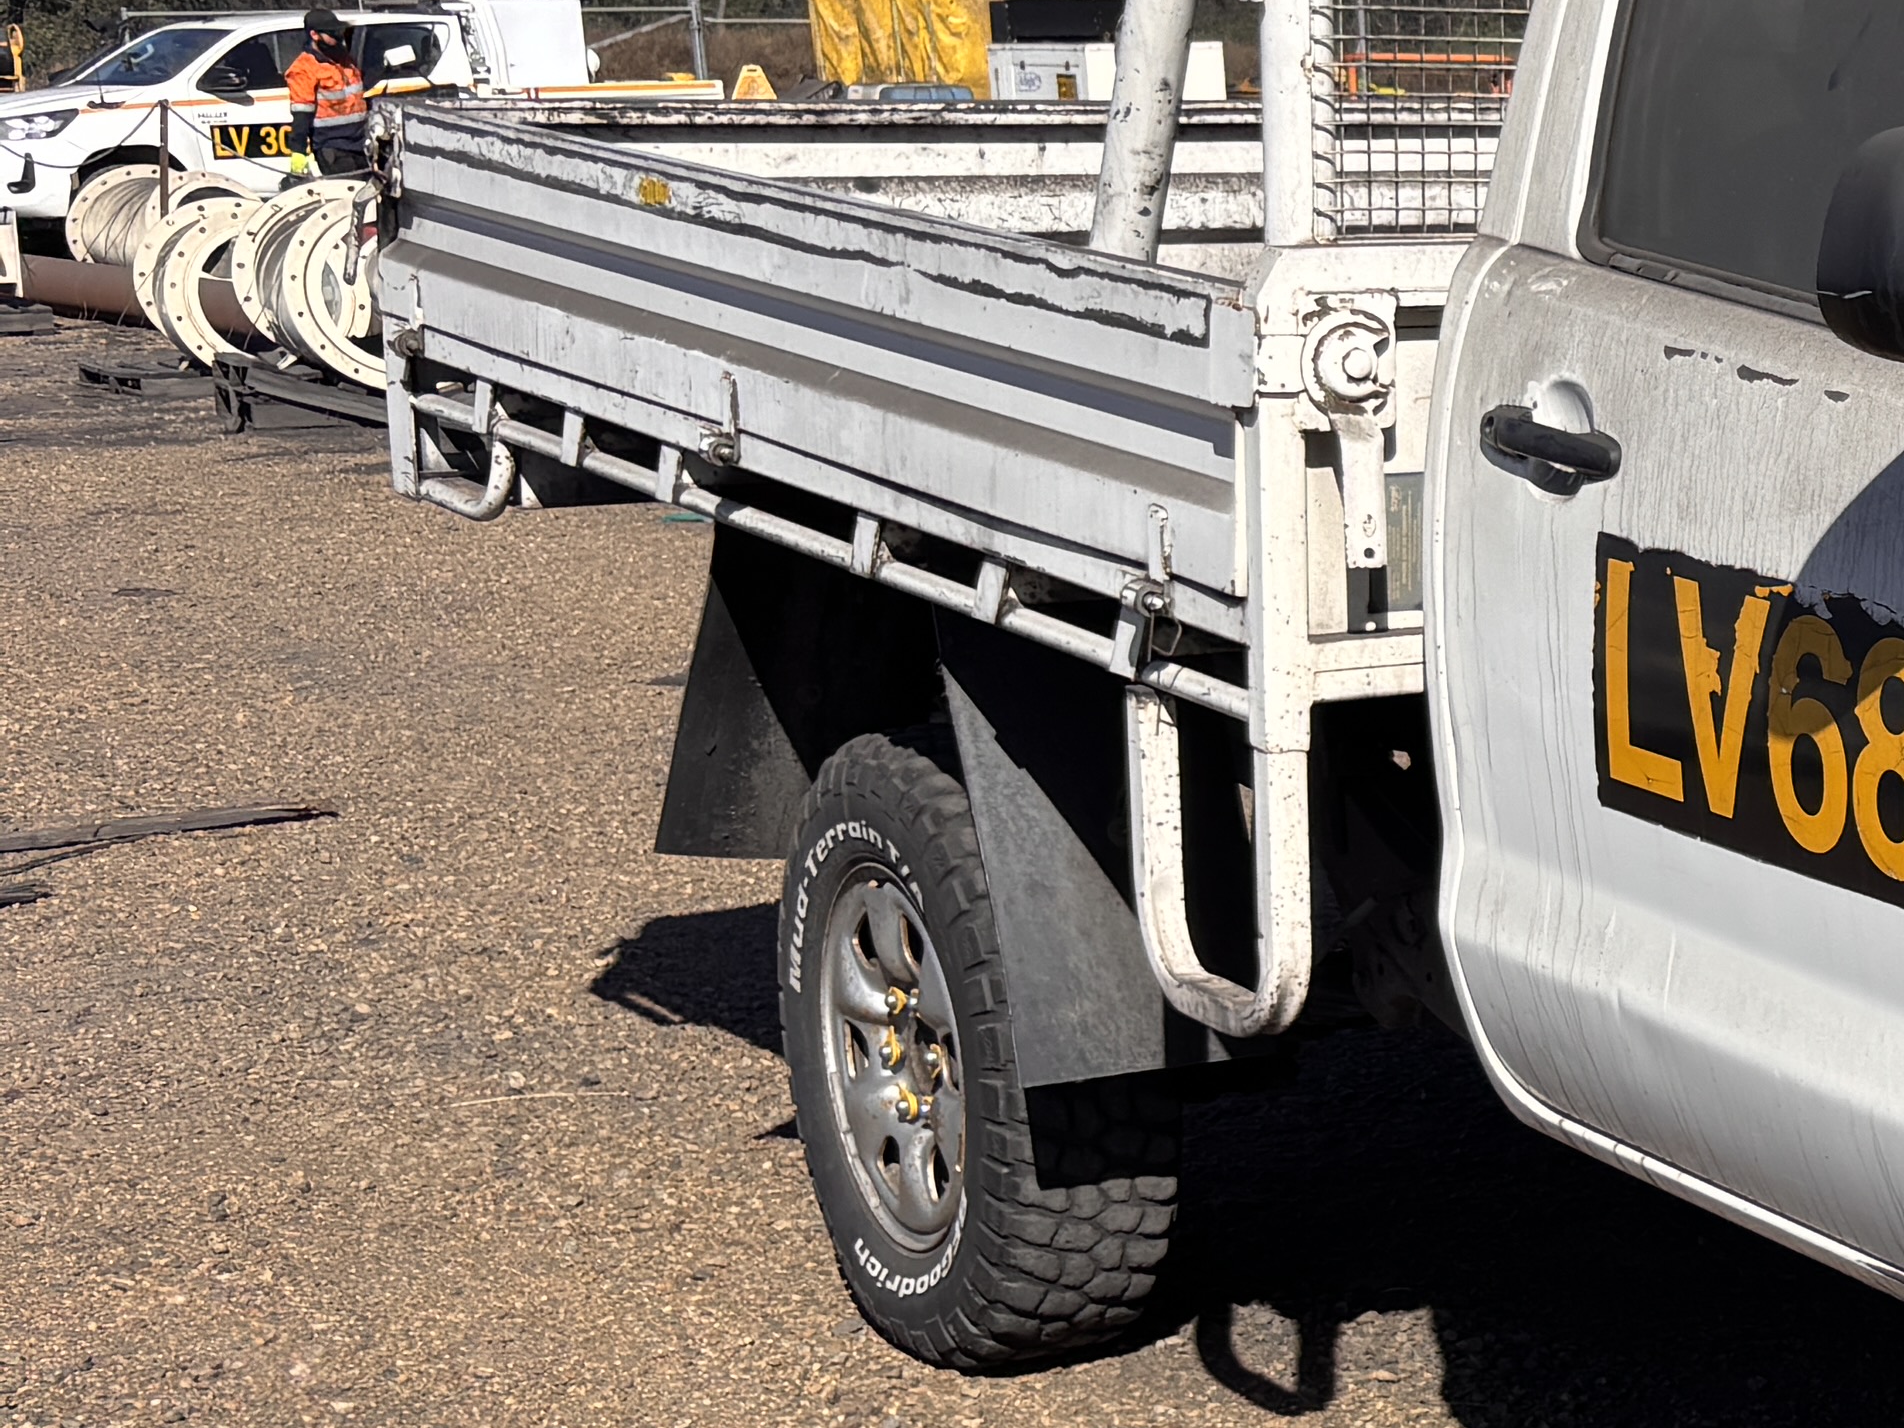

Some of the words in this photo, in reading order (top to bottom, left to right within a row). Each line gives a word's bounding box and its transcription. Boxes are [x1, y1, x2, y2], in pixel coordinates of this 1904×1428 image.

[213, 127, 249, 157] LV
[260, 126, 293, 155] 30
[789, 820, 883, 993] Mud-Terrain
